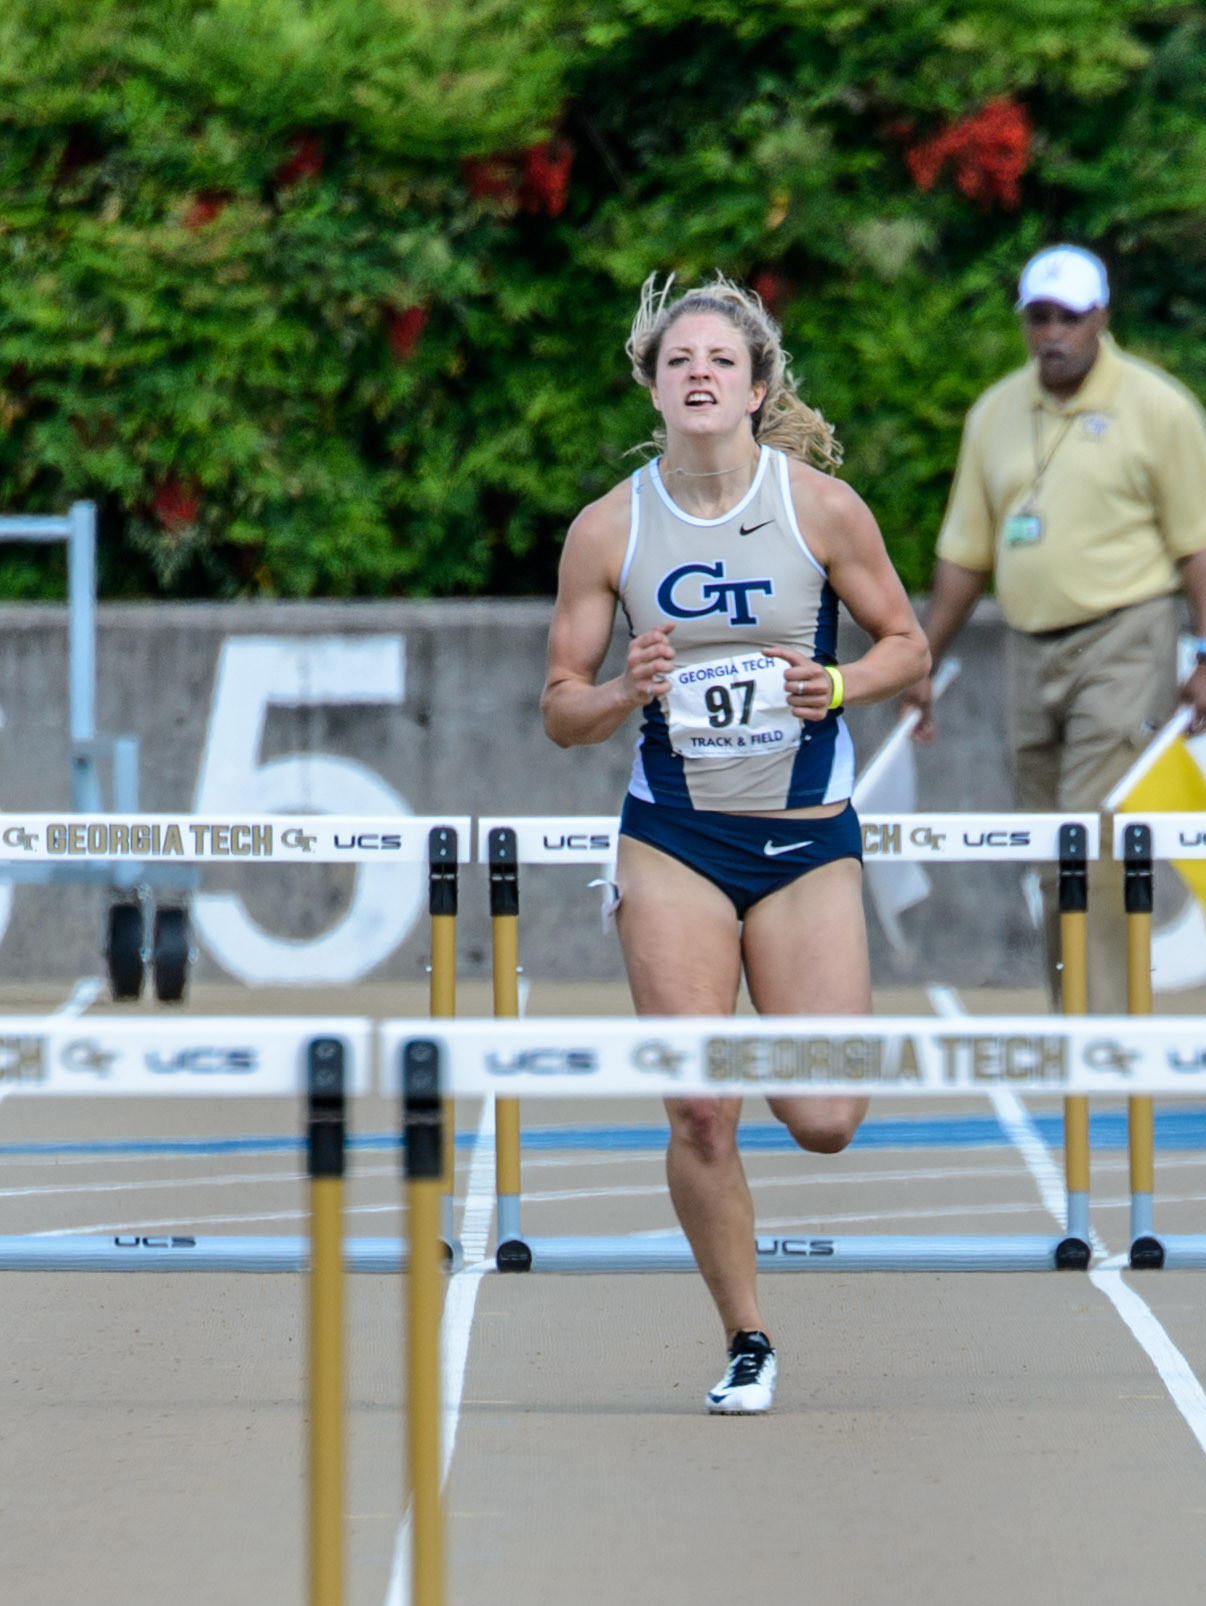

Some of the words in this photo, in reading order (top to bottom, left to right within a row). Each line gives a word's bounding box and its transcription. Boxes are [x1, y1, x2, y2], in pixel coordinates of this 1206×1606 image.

[656, 560, 774, 627] GT
[678, 664, 739, 684] GEORGIA
[742, 658, 775, 672] TECH
[705, 680, 756, 728] 97
[690, 737, 732, 748] TRACK
[737, 737, 746, 747] &
[751, 730, 784, 745] FIELD
[46, 823, 184, 855] GEORGIA
[189, 824, 273, 856] TECH
[333, 833, 402, 850] UCS
[542, 833, 611, 849] UCS
[860, 823, 901, 854] CH
[963, 831, 1031, 847] UCS
[144, 1046, 258, 1075] UCS
[485, 1045, 600, 1075] UCS
[703, 1034, 924, 1084] GEORGIA
[934, 1034, 1070, 1083] TECH
[115, 1236, 195, 1247] UCS
[754, 1239, 834, 1256] UCS
